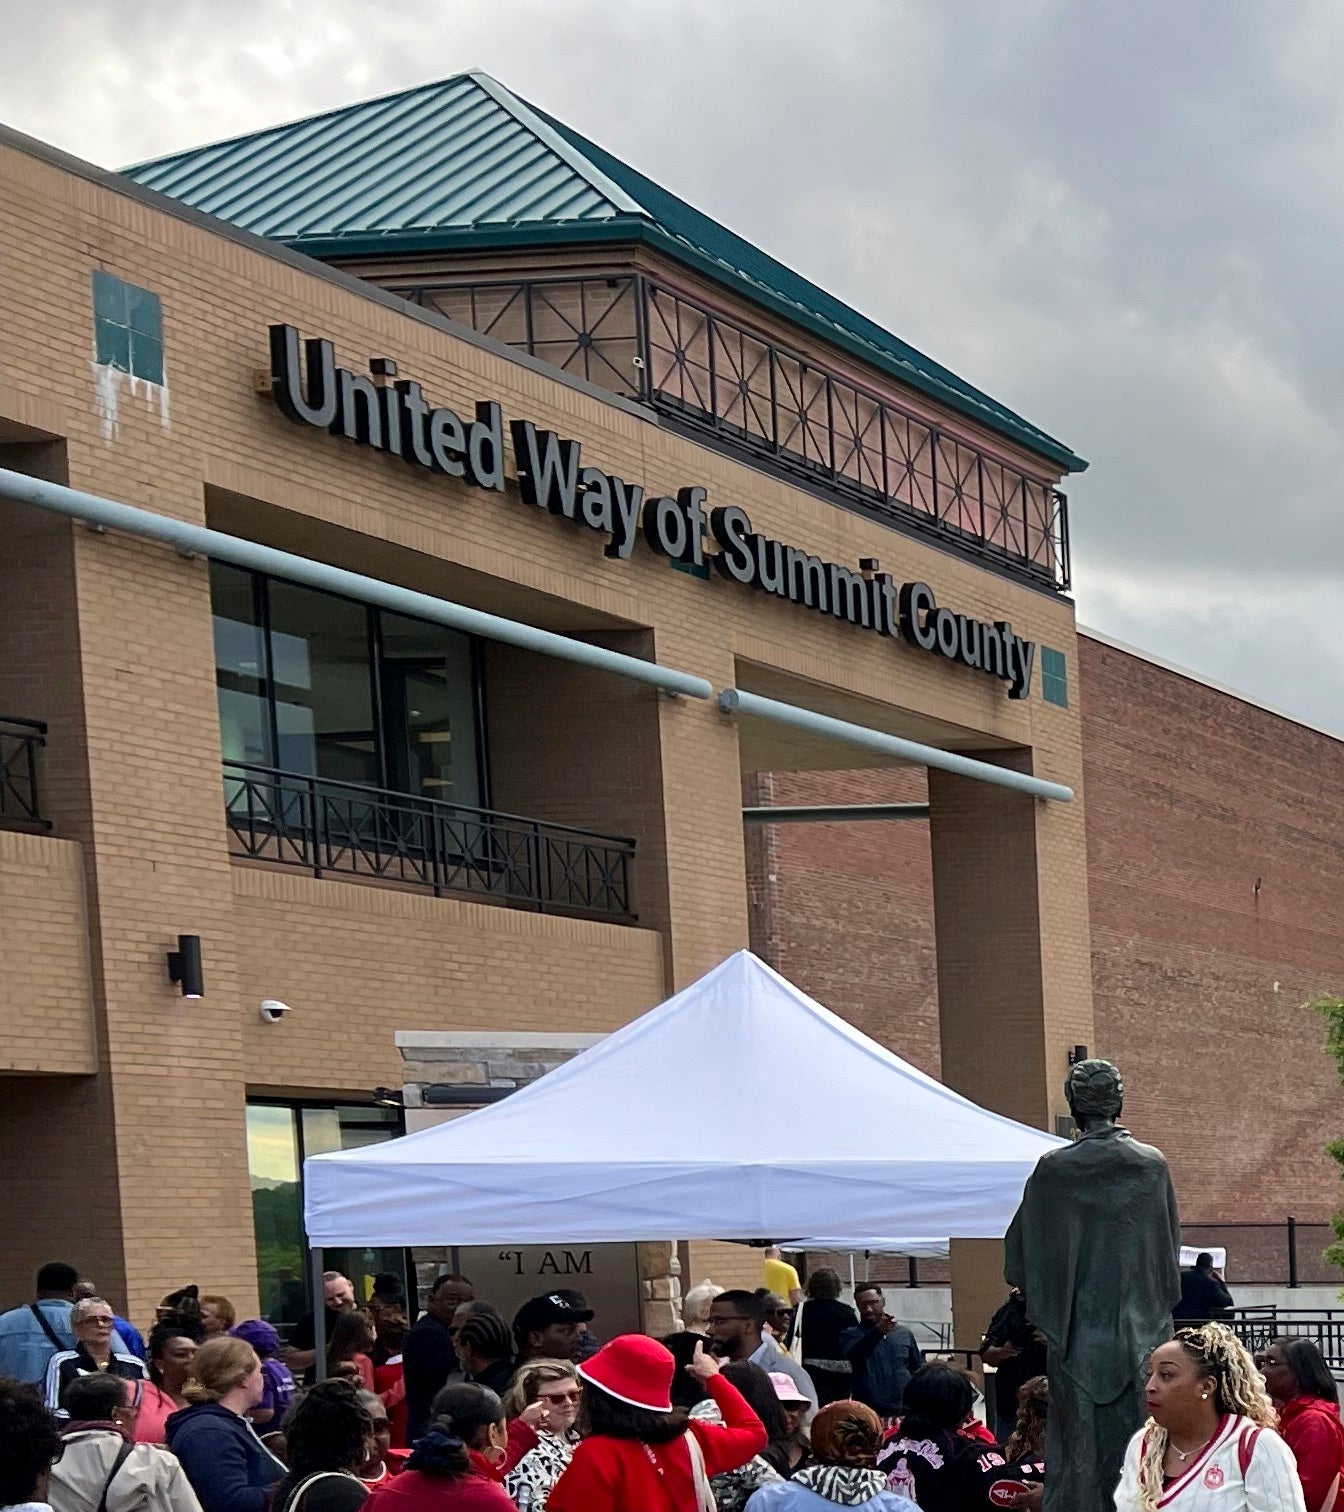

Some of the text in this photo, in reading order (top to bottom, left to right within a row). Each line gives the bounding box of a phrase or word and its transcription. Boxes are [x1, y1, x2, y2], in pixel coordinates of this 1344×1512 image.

[269, 323, 1036, 701] United Way of Summit County
[537, 1250, 594, 1275] AM
